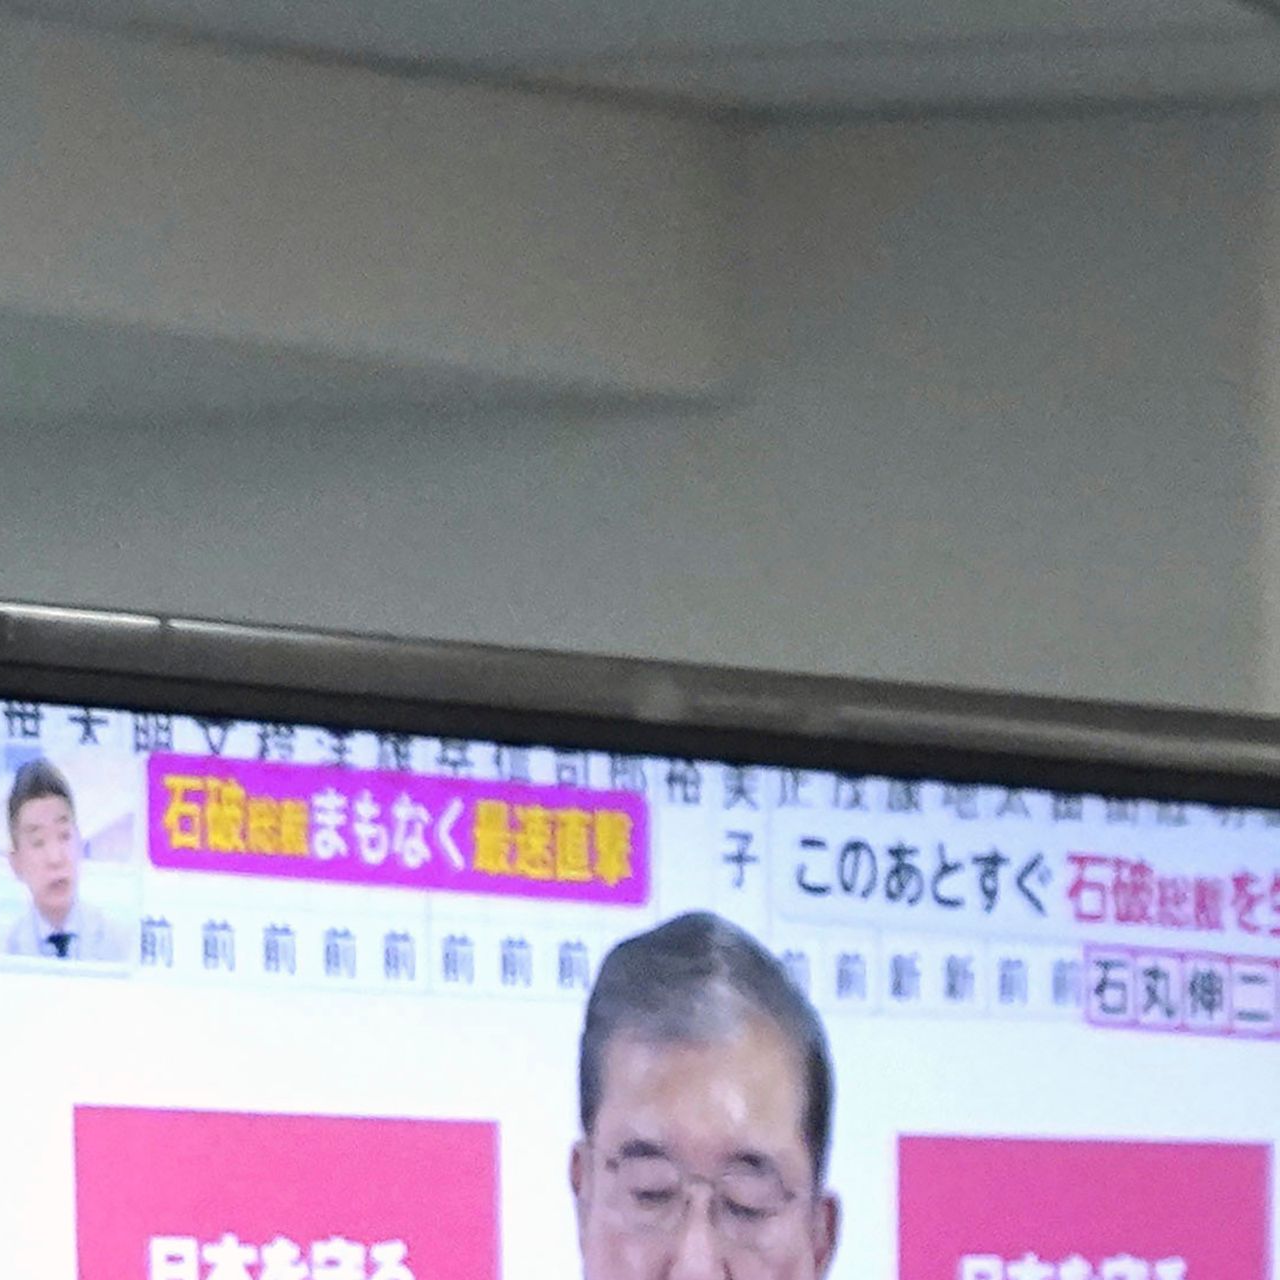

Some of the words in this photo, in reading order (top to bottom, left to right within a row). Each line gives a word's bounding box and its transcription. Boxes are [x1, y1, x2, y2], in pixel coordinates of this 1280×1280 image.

[797, 834, 1280, 937] このあとすぐ石破総裁を
[142, 915, 174, 969] 前
[202, 919, 235, 972] 前
[263, 923, 296, 975] 前
[325, 927, 357, 978] 前
[384, 930, 416, 981] 前
[442, 933, 475, 985] 前
[500, 936, 533, 987] 前
[558, 939, 591, 990] 前
[1093, 957, 1271, 1022] 石丸伸二
